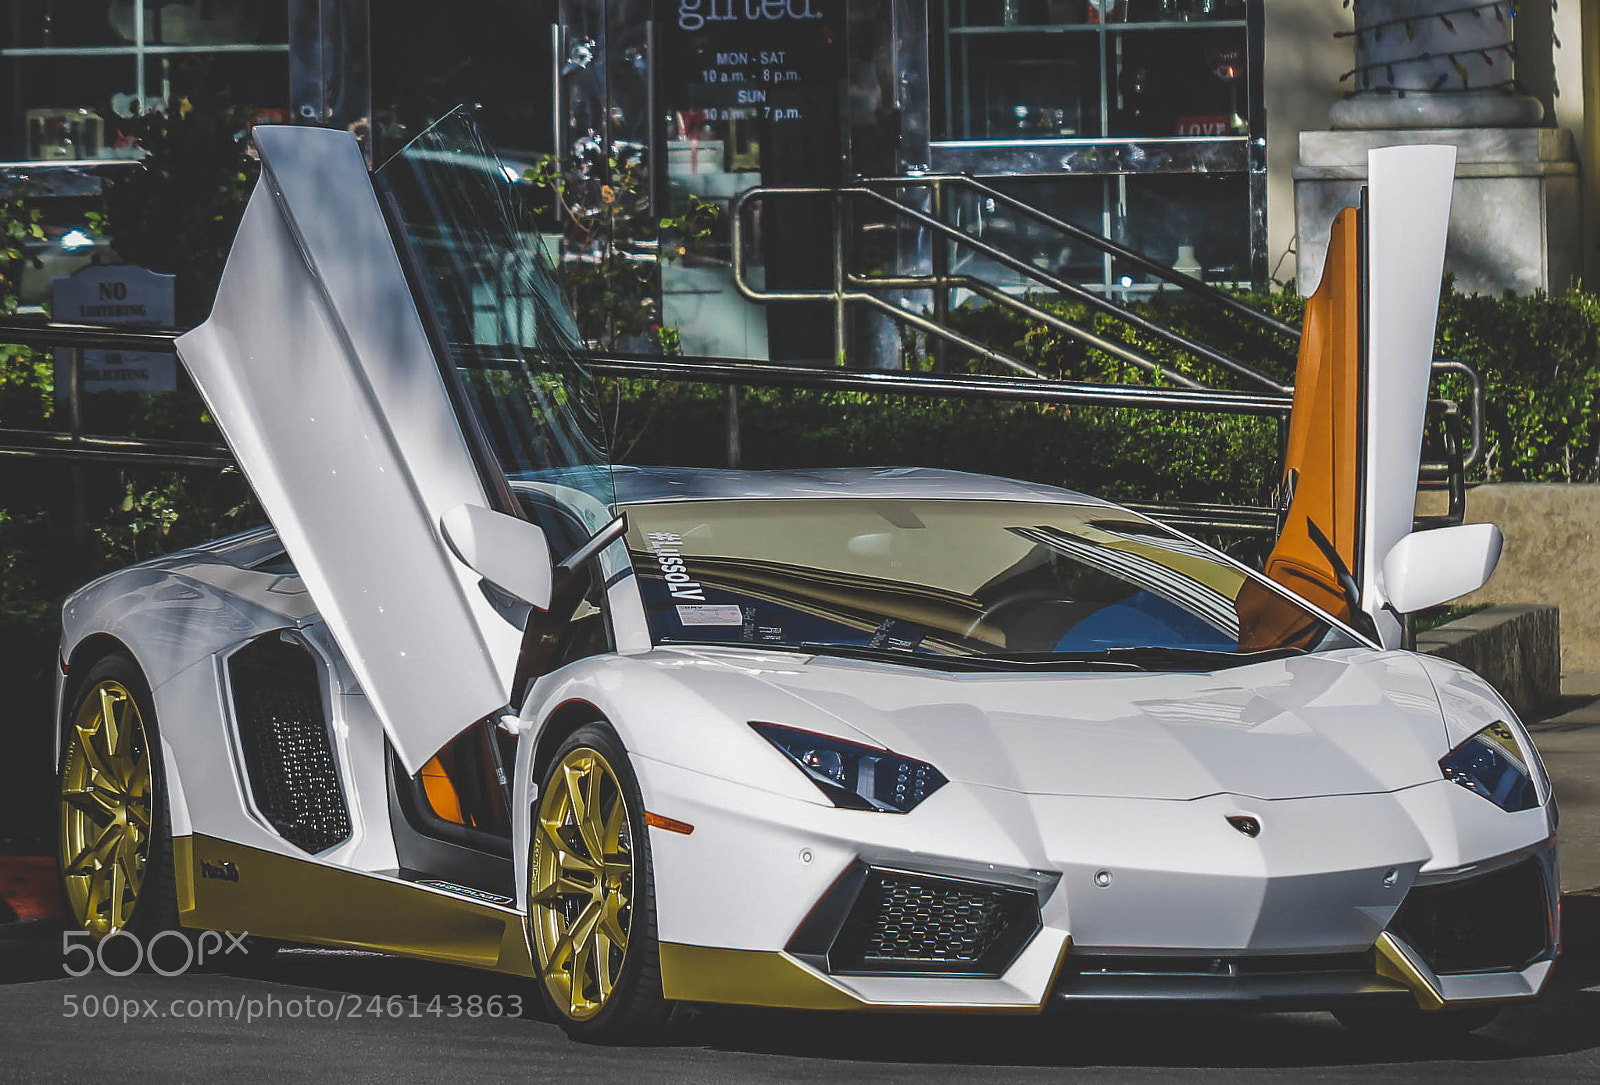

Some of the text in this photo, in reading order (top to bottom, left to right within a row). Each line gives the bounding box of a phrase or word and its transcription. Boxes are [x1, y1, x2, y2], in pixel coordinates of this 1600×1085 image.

[716, 52, 748, 65] MON
[760, 51, 786, 64] SAT
[703, 69, 717, 82] 10
[721, 71, 748, 82] a.m.
[763, 69, 771, 82] 8
[775, 71, 802, 84] p.m.
[738, 90, 767, 103] SUN
[703, 108, 718, 120] 10
[721, 109, 748, 120] a.m.
[764, 107, 771, 119] 7
[775, 108, 802, 121] p.m.
[98, 282, 128, 300] NO
[85, 368, 149, 381] OLICITING
